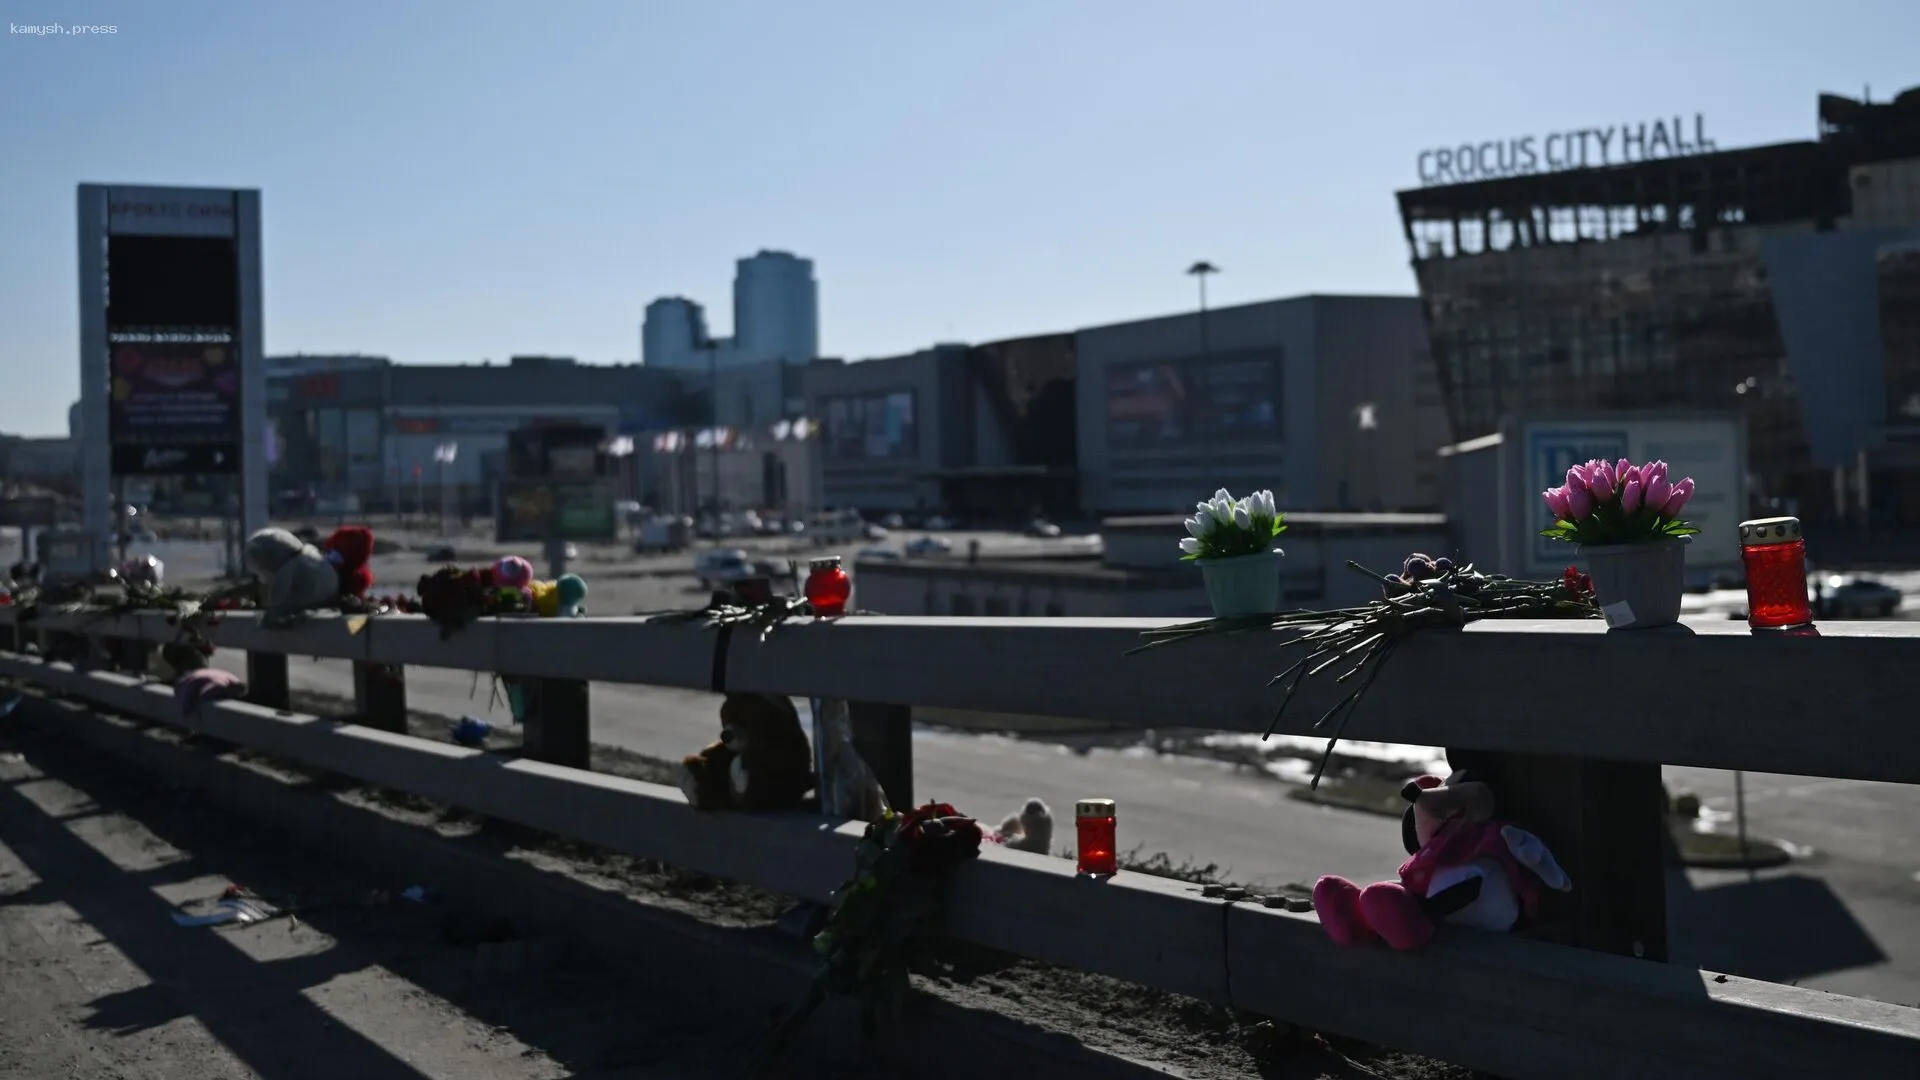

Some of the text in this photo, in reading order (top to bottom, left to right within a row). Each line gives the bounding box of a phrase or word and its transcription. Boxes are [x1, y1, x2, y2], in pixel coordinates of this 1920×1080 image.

[1417, 112, 1716, 182] CROCUS CITY HALL
